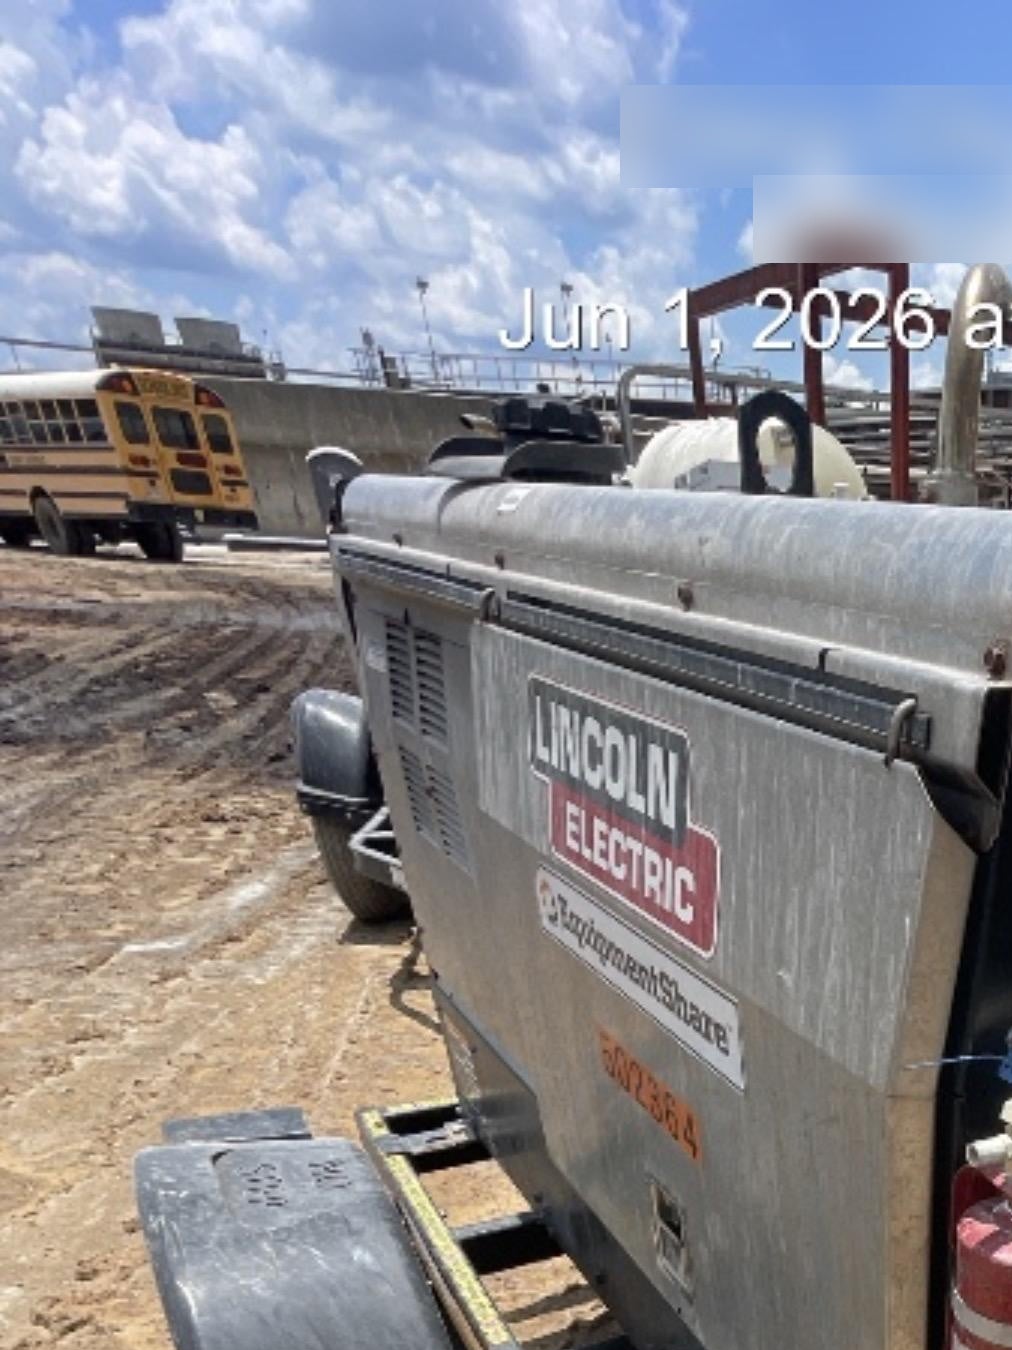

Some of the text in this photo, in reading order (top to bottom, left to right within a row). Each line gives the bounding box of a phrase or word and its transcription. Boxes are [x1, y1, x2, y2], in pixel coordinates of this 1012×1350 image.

[535, 695, 680, 830] LINCOLN
[565, 799, 696, 926] ELECTRIC
[557, 893, 730, 1057] EquipmentShare
[601, 1031, 699, 1160] 502364
